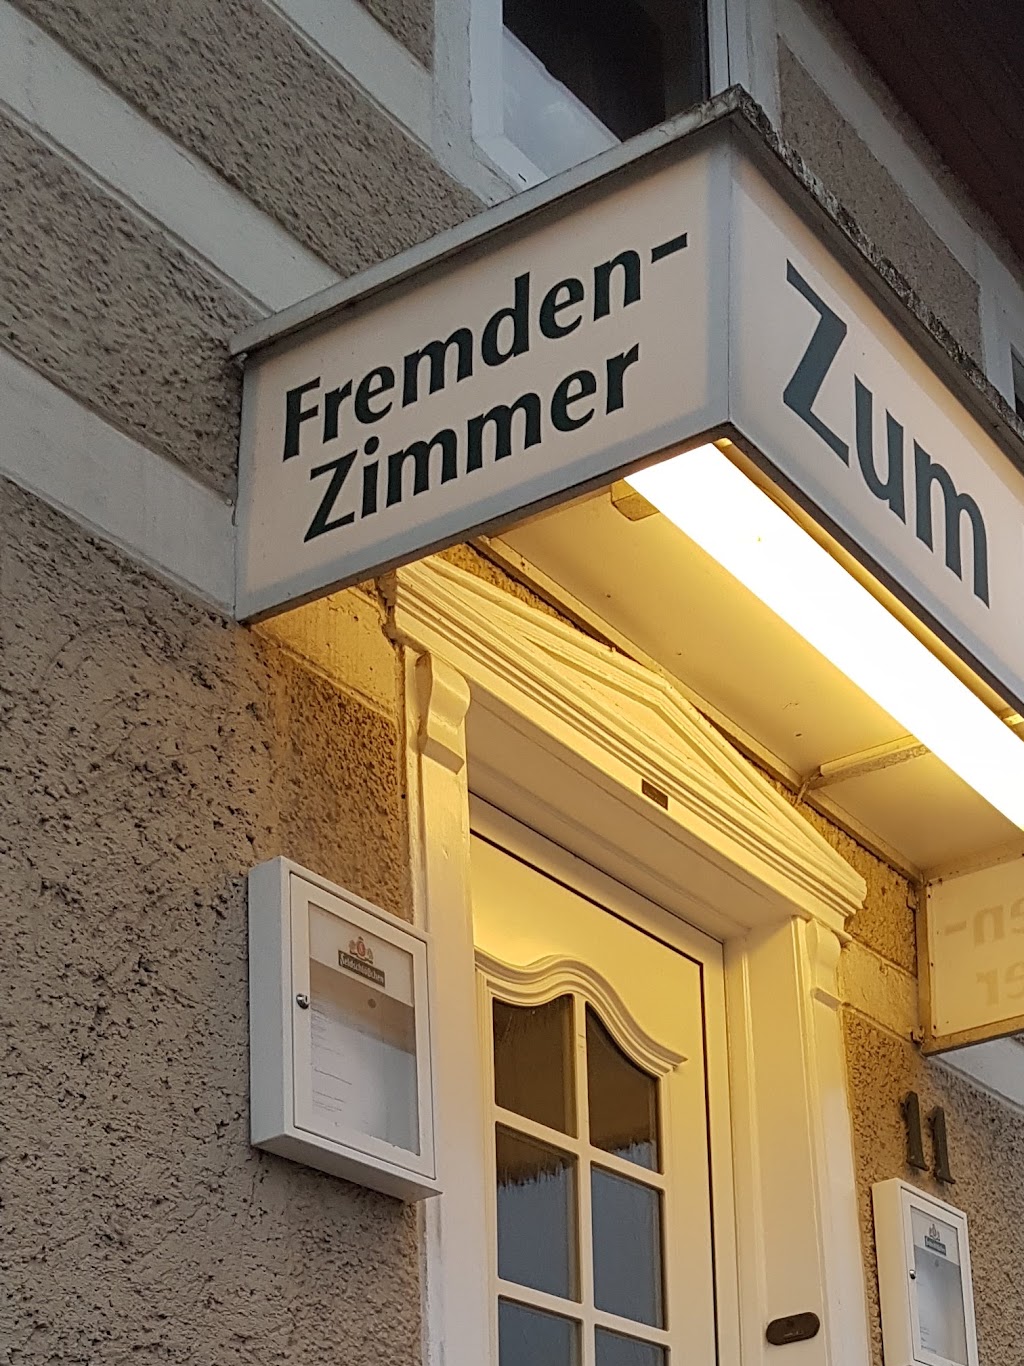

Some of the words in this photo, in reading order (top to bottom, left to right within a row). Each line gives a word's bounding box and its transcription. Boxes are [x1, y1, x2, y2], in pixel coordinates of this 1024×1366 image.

[282, 232, 688, 462] Fremden-
[304, 343, 640, 543] Zimmer
[782, 258, 990, 608] Zum
[900, 1088, 956, 1184] 11
